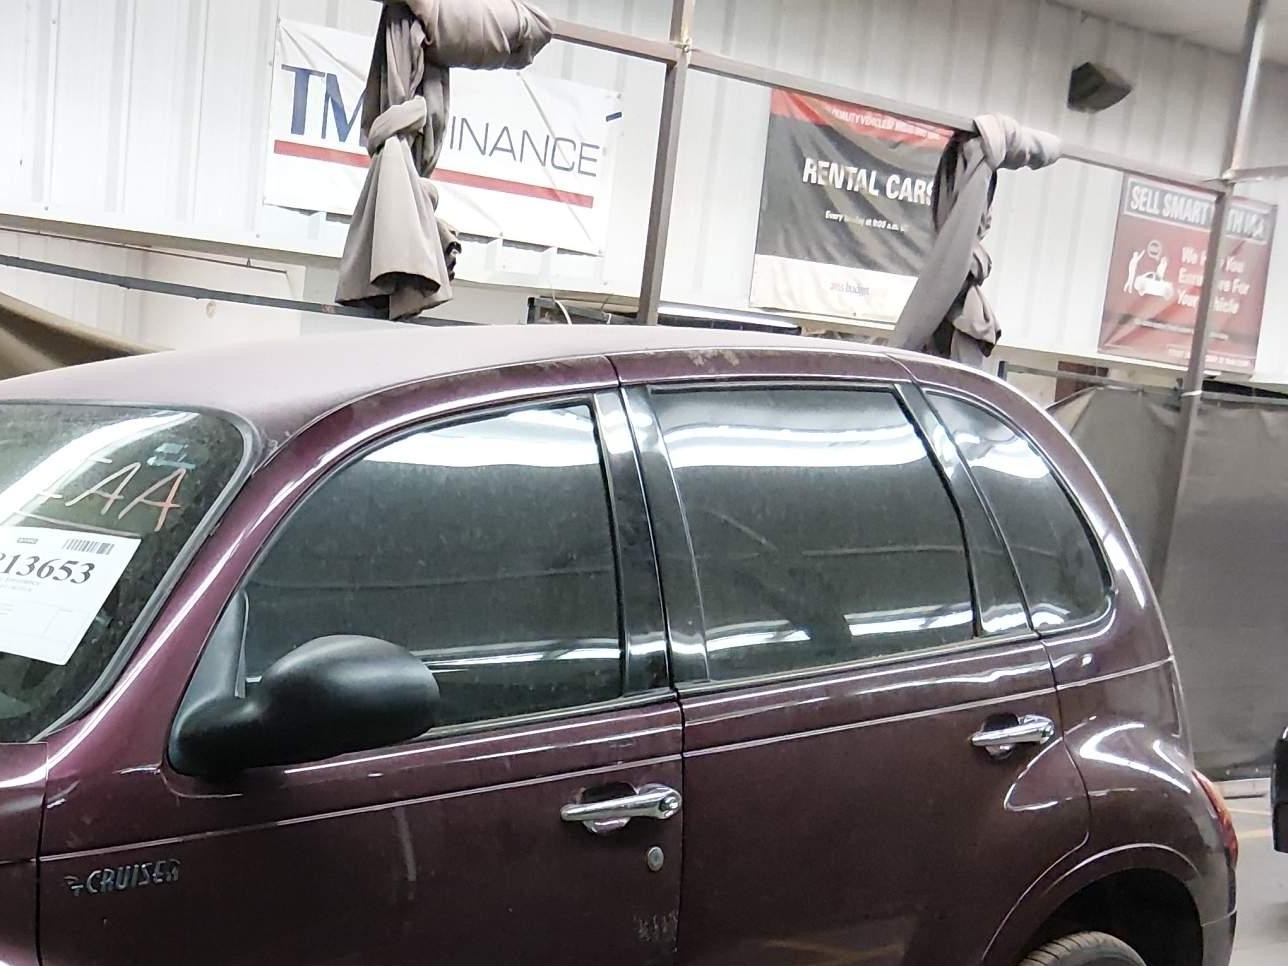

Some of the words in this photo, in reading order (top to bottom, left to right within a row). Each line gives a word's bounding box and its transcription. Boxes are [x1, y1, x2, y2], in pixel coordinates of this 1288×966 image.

[449, 115, 600, 177] INANCE
[802, 157, 879, 196] RENTAL
[885, 174, 934, 207] CARS
[1130, 185, 1159, 215] SELL
[1162, 192, 1210, 226] SMART
[86, 858, 181, 894] CRUISER
